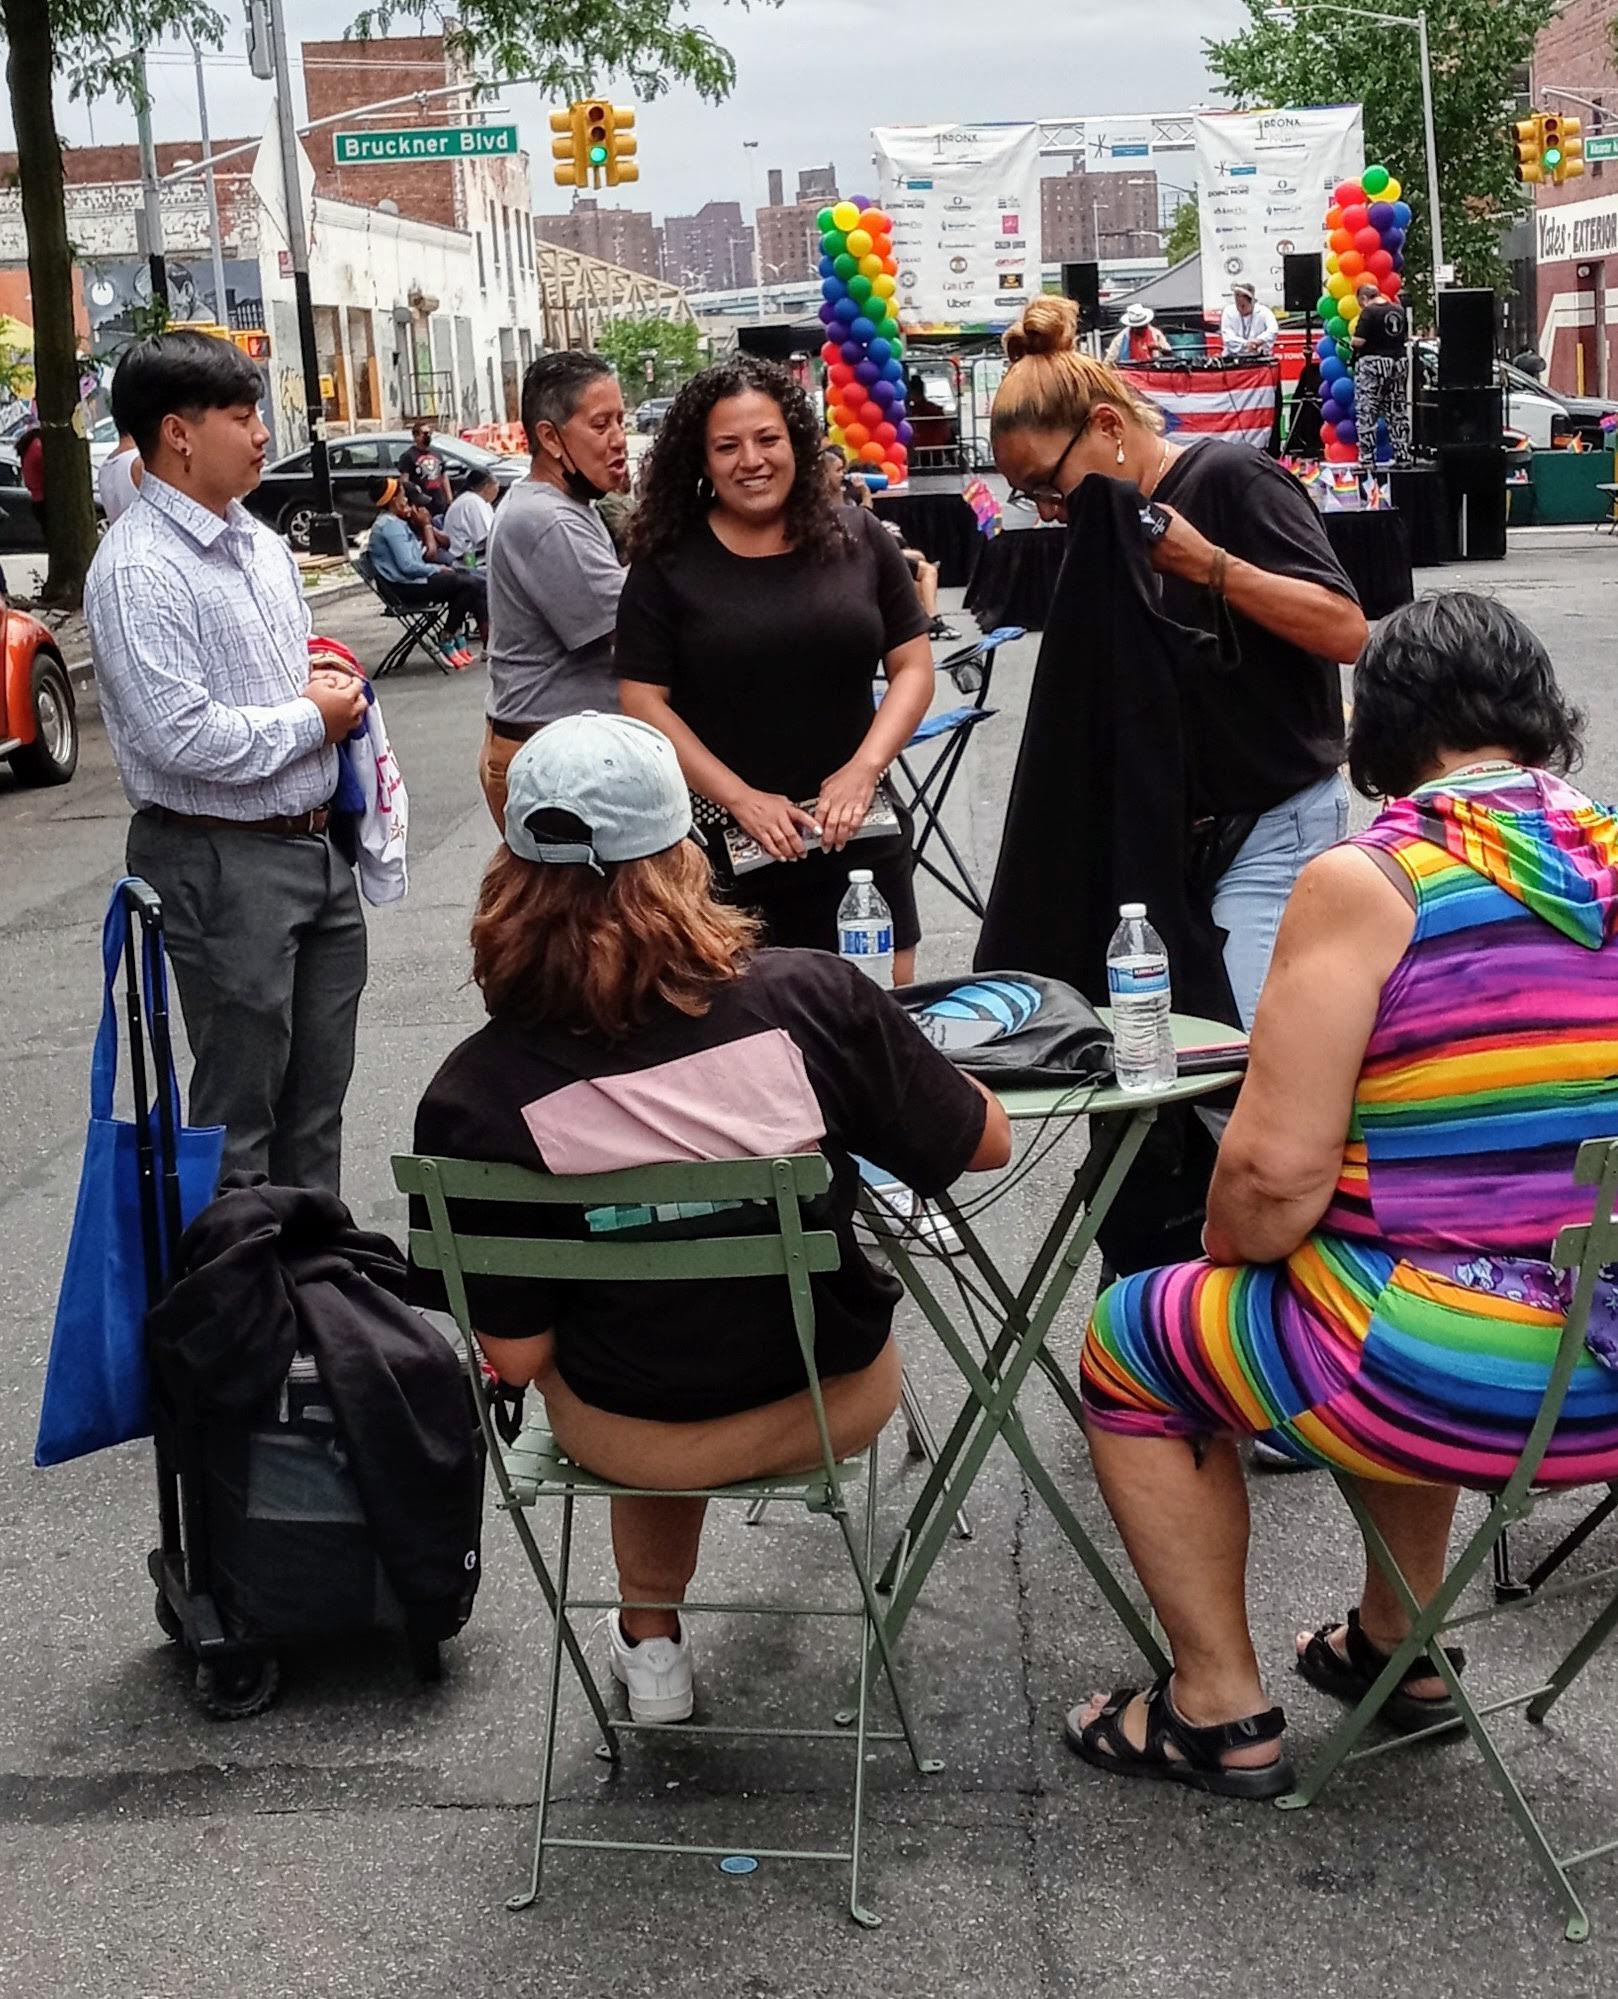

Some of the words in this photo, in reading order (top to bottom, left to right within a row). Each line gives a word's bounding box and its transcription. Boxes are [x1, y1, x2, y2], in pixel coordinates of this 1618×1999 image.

[345, 137, 449, 158] Bruckner
[460, 131, 509, 151] Blvd
[1573, 212, 1617, 253] EXTERIOR
[946, 299, 972, 308] Uber
